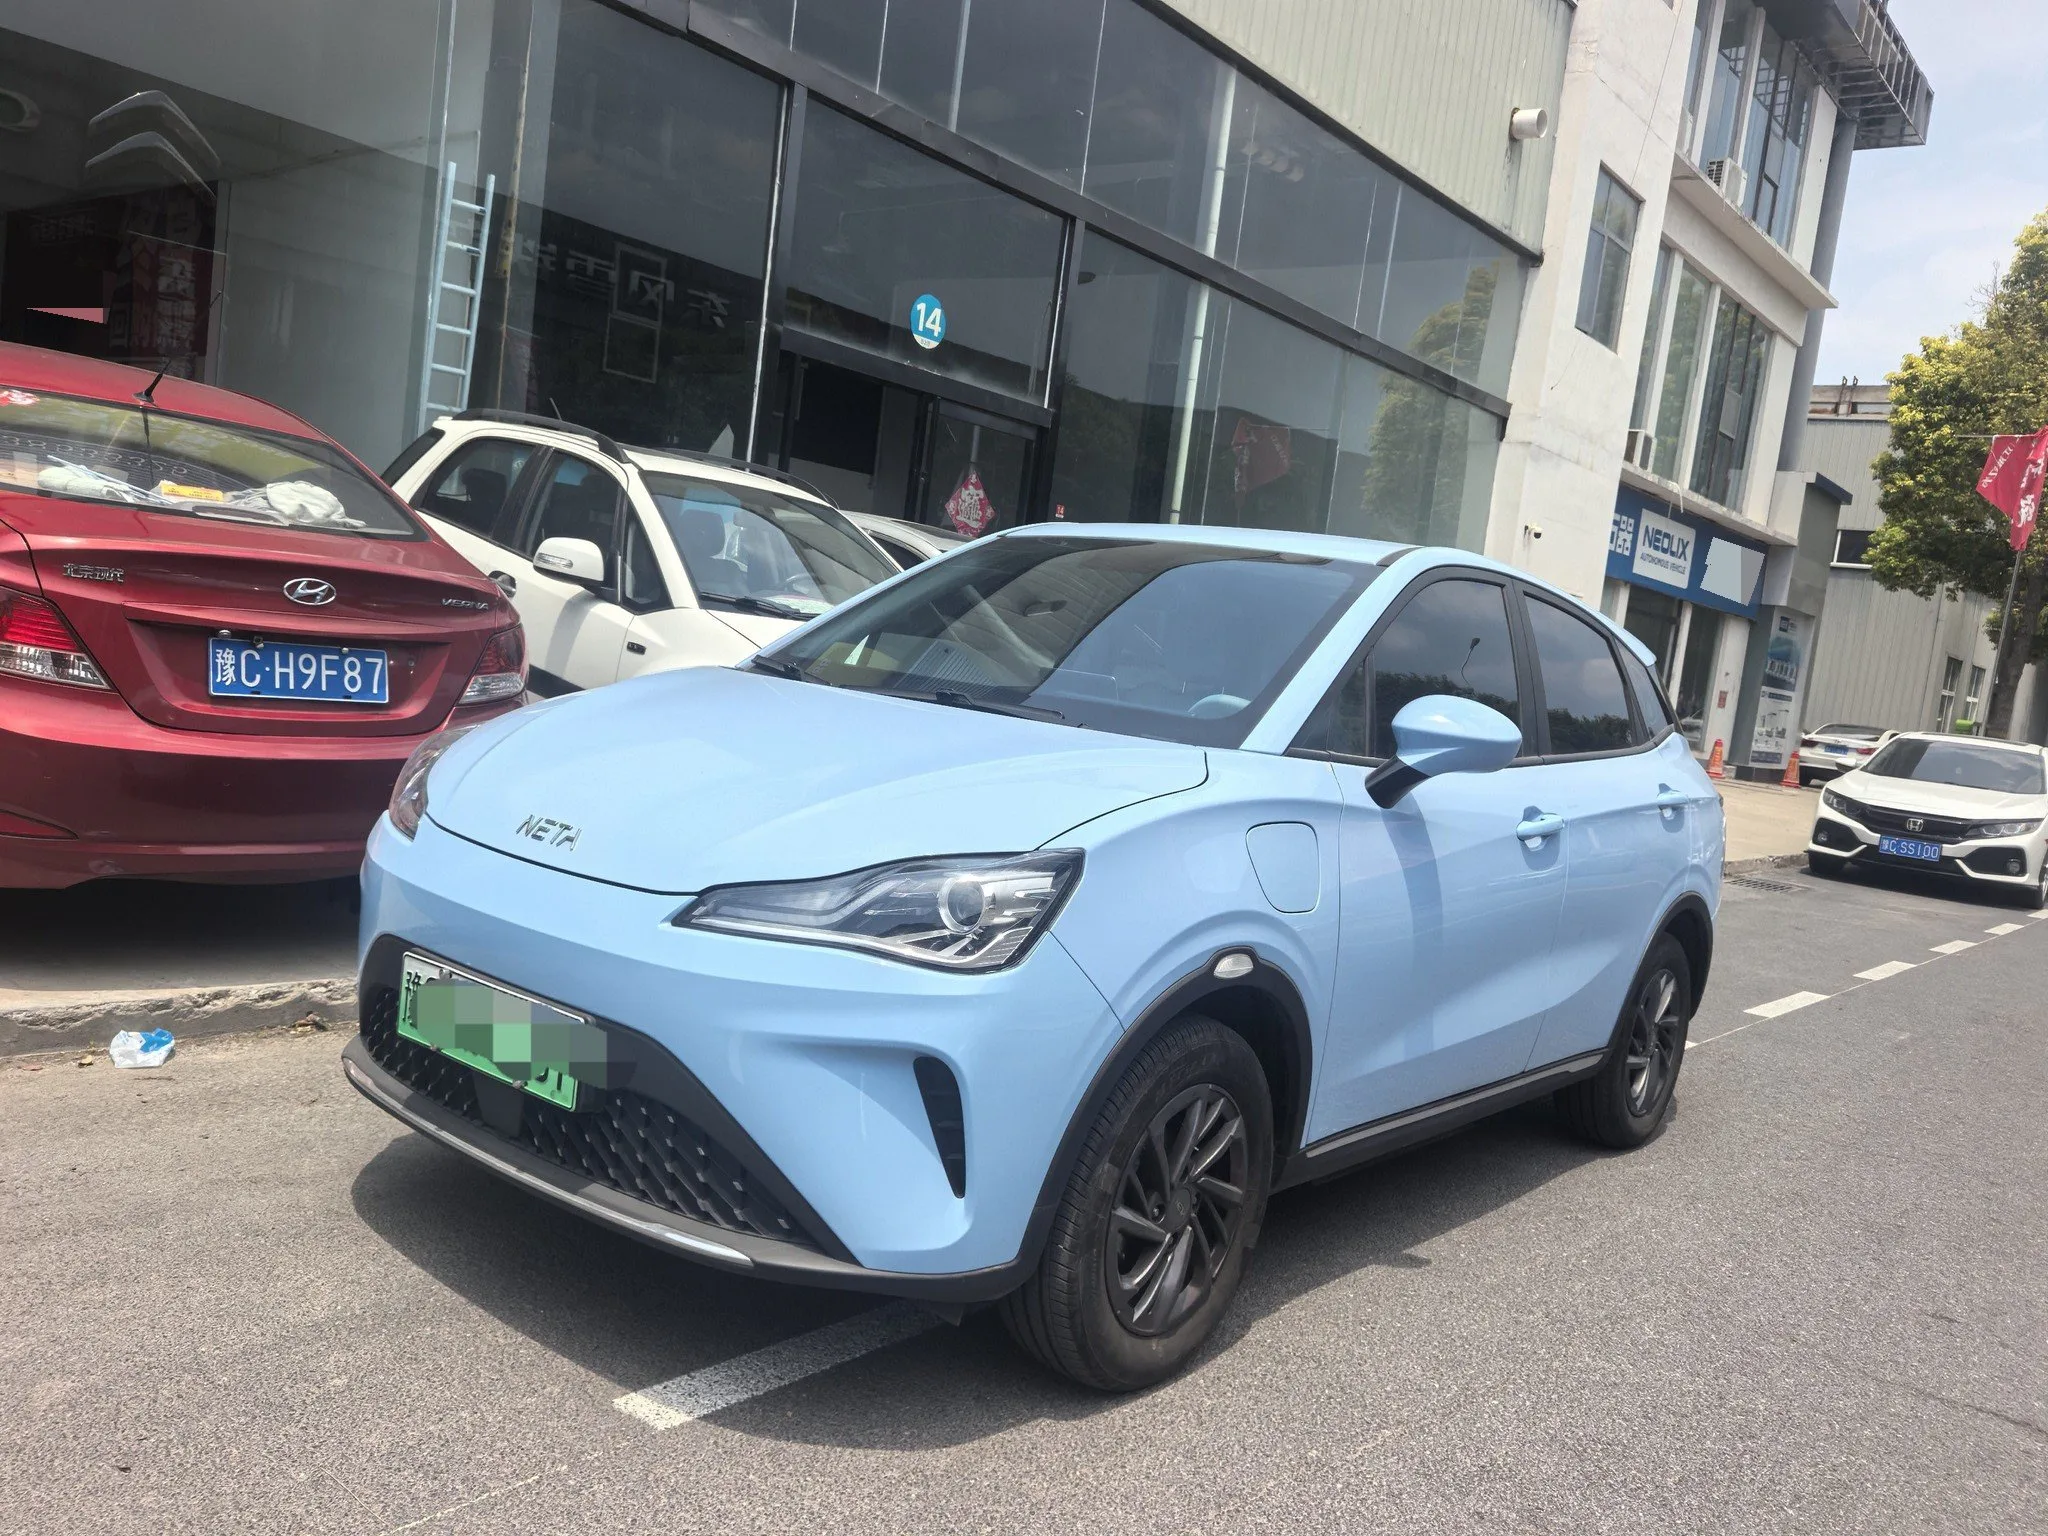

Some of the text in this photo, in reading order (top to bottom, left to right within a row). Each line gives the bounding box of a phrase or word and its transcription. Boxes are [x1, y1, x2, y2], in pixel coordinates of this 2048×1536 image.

[916, 302, 942, 338] 14
[1642, 524, 1690, 562] NEOLIX
[62, 562, 124, 583] 北京现代
[1640, 551, 1686, 575] AUTONOMOUS VEHICLE
[441, 598, 489, 610] VERNA
[515, 813, 583, 852] NETA
